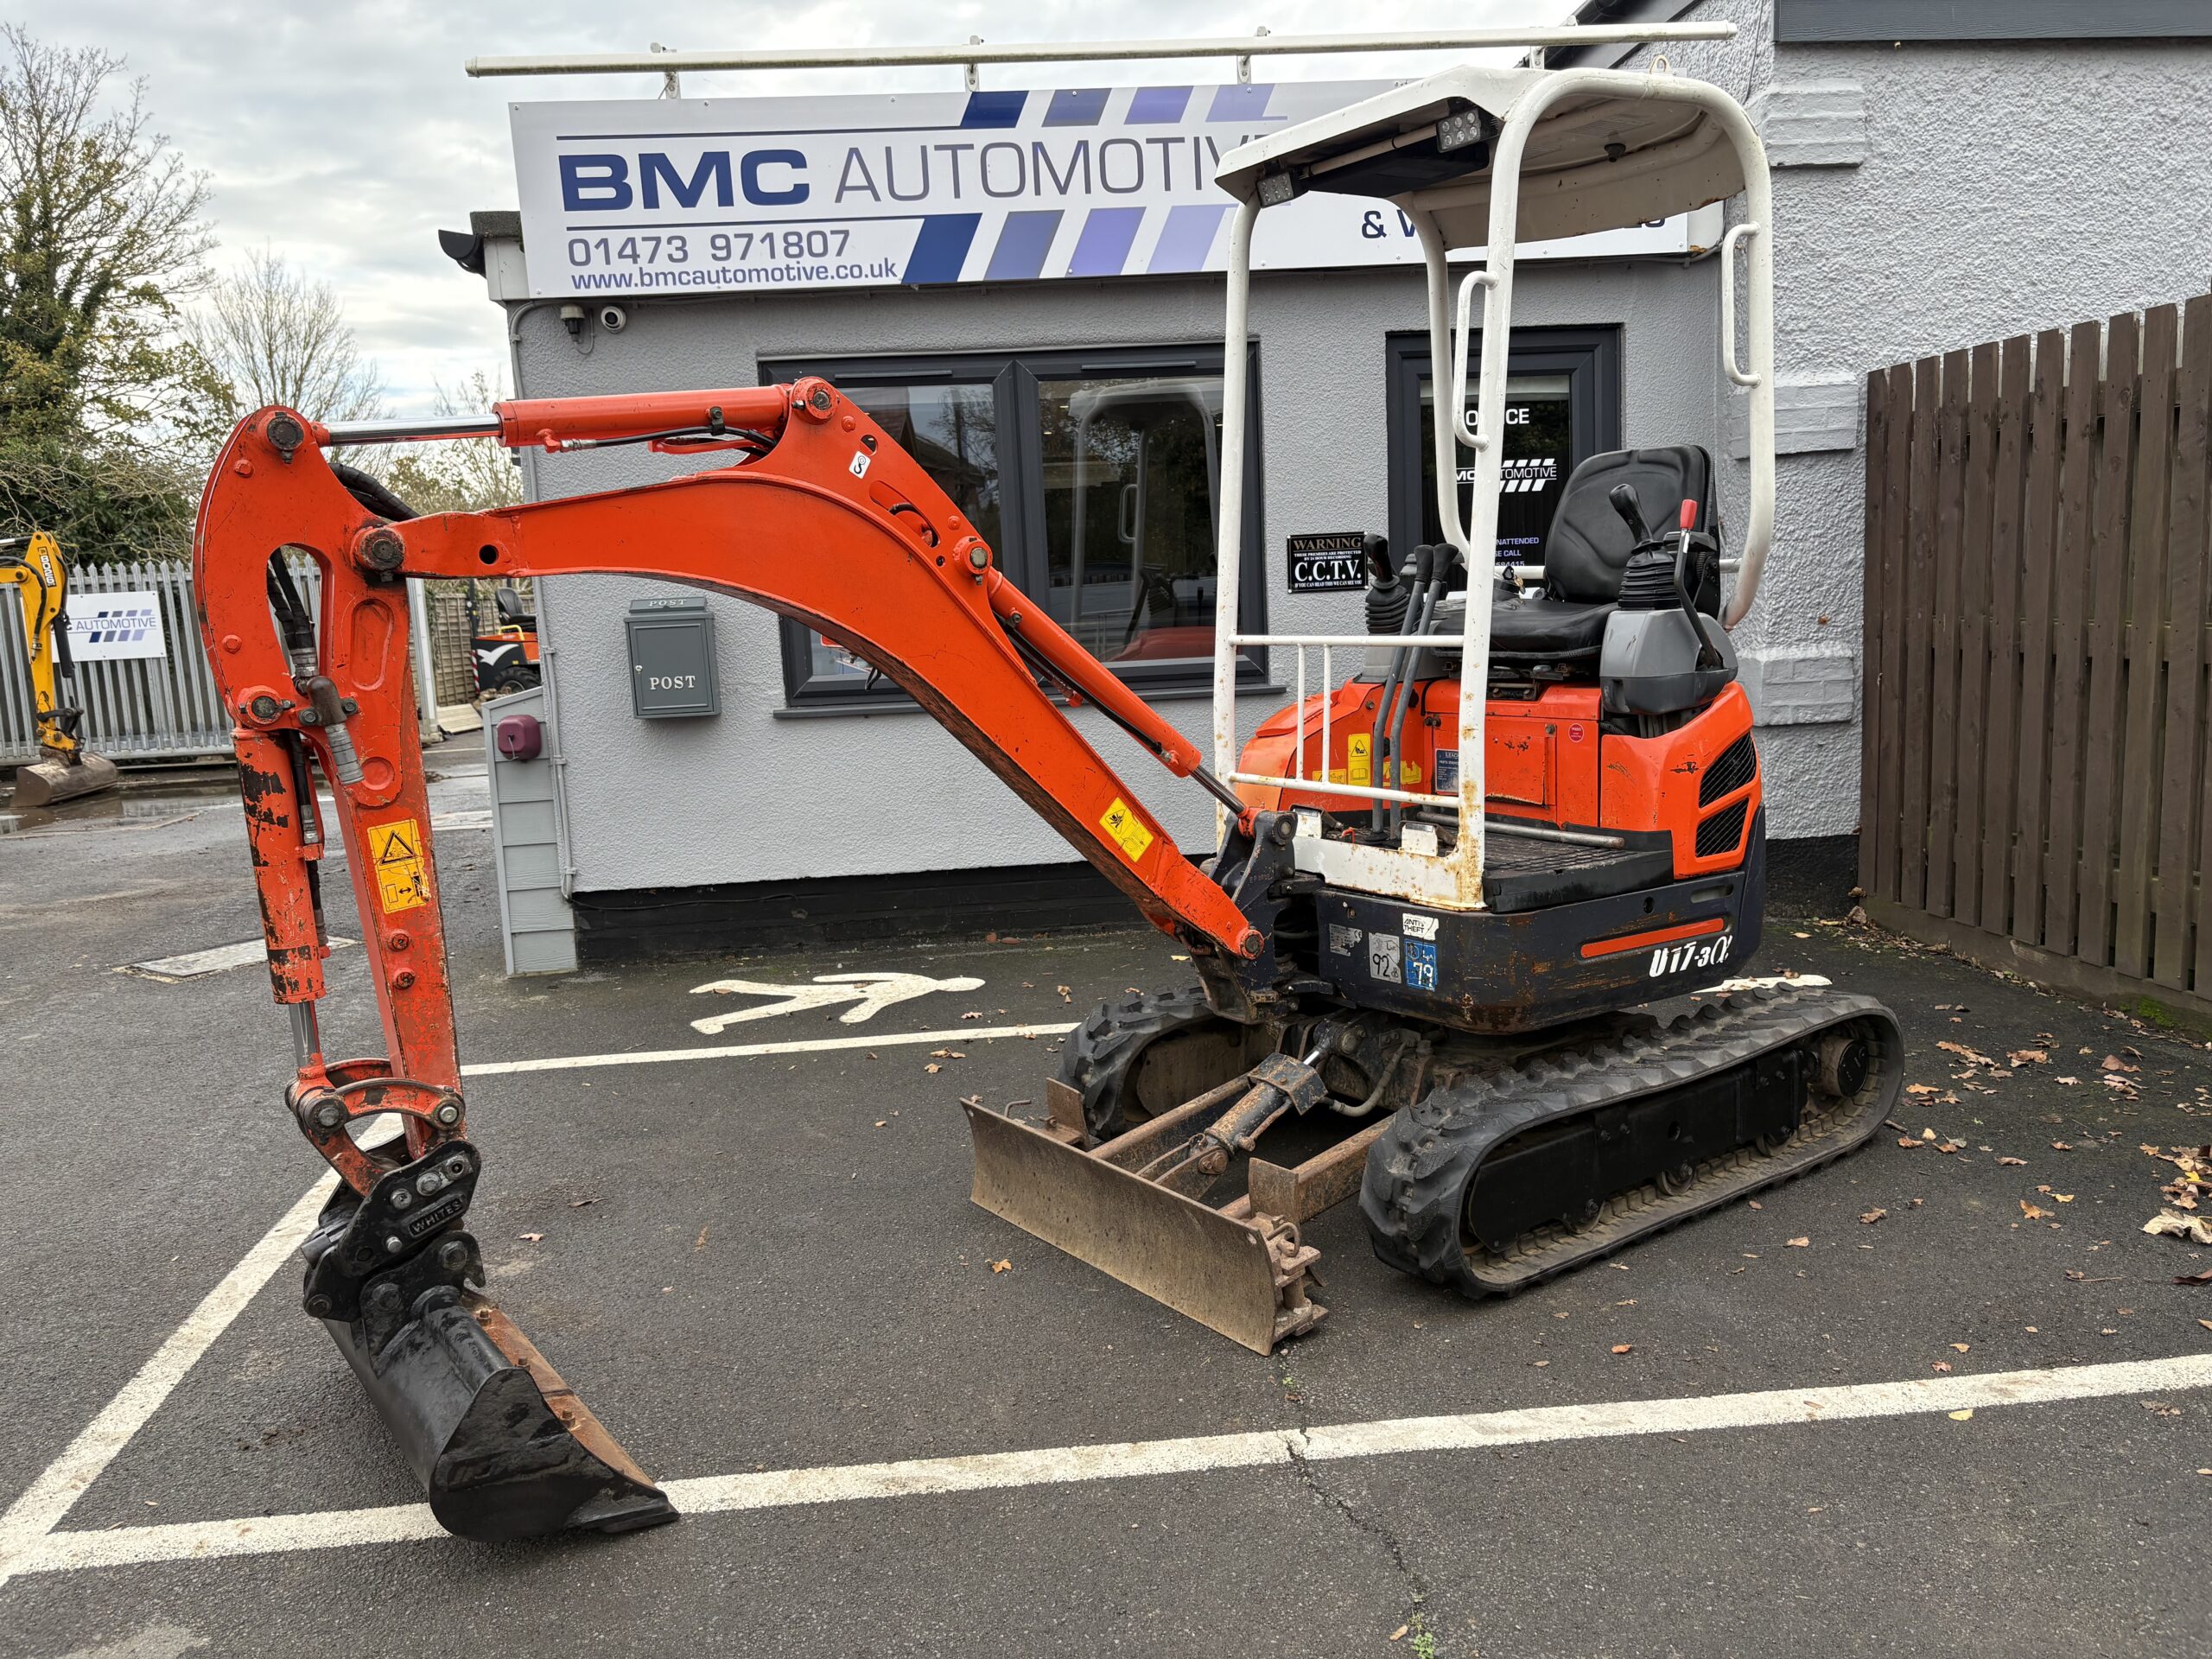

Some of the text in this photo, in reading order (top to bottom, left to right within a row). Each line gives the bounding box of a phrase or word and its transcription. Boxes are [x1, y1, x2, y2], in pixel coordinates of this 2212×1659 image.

[558, 135, 1267, 212] BMC AUTOMOTI
[1361, 210, 1387, 239] &
[568, 229, 850, 266] 01473 971807
[571, 257, 899, 289] www.bmcautomotive.co.uk
[1500, 467, 1557, 480] TOMOTIVE
[1294, 537, 1362, 550] WARNING
[1496, 537, 1540, 546] NATTENDED
[1294, 559, 1362, 582] C.C.T.V.
[76, 617, 156, 631] AUTOMOTIVE
[649, 675, 696, 690] POST
[1403, 925, 1425, 934] THEFT
[1372, 953, 1390, 978] 92
[1413, 962, 1433, 988] 79
[411, 1199, 462, 1233] WHITES
